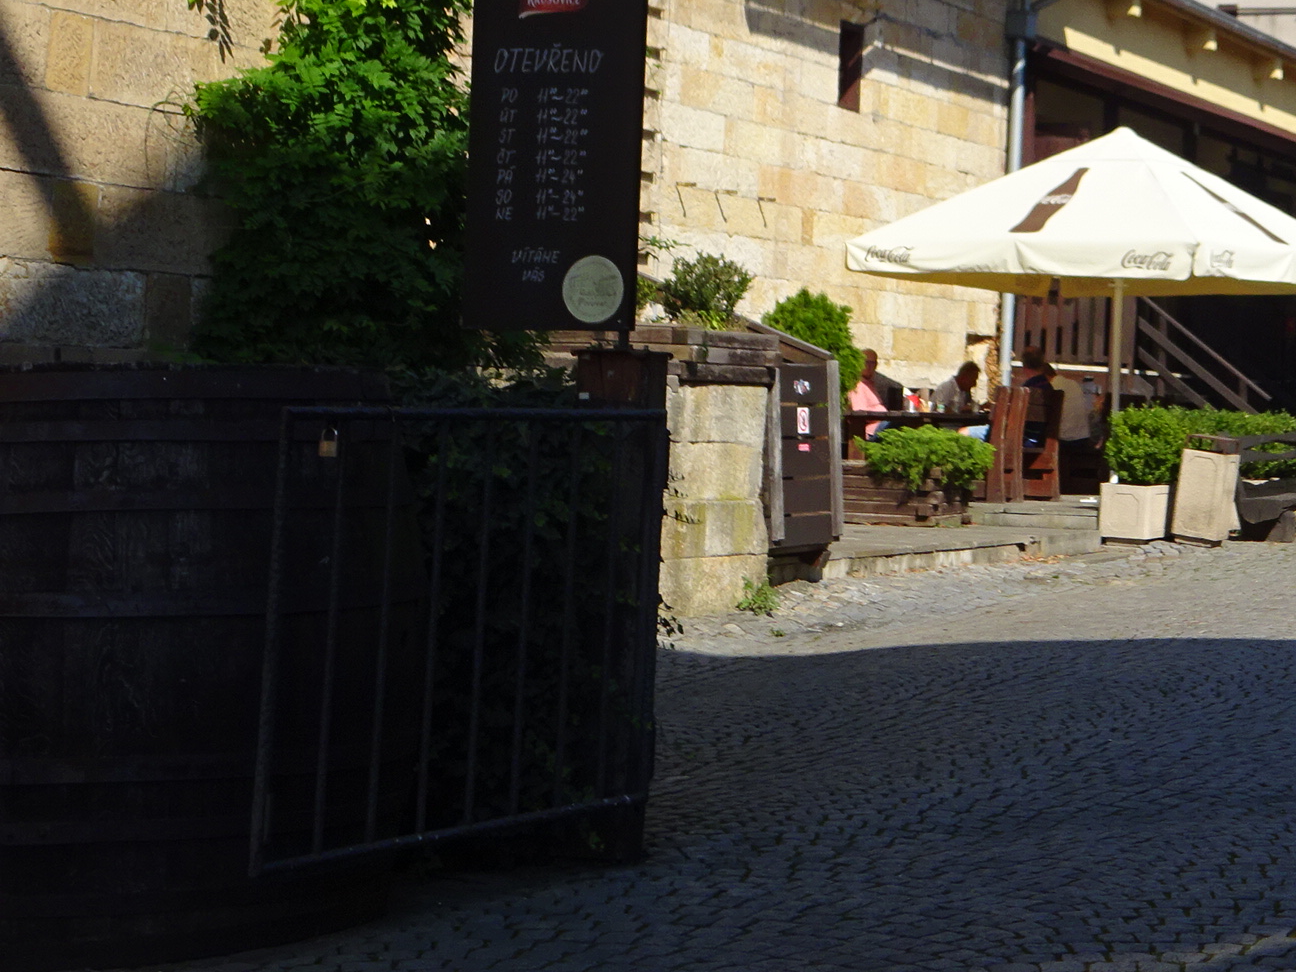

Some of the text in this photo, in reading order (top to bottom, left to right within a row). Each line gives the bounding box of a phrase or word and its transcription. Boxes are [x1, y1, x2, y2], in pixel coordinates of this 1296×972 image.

[493, 42, 605, 74] OTEVŘENO
[500, 87, 519, 103] PO
[499, 106, 518, 123] ÚT
[498, 127, 516, 144] ST
[496, 147, 517, 165] ČT
[496, 165, 517, 185] PÁ
[495, 188, 513, 205] SO
[495, 206, 514, 221] NE
[521, 266, 546, 282] VÁS
